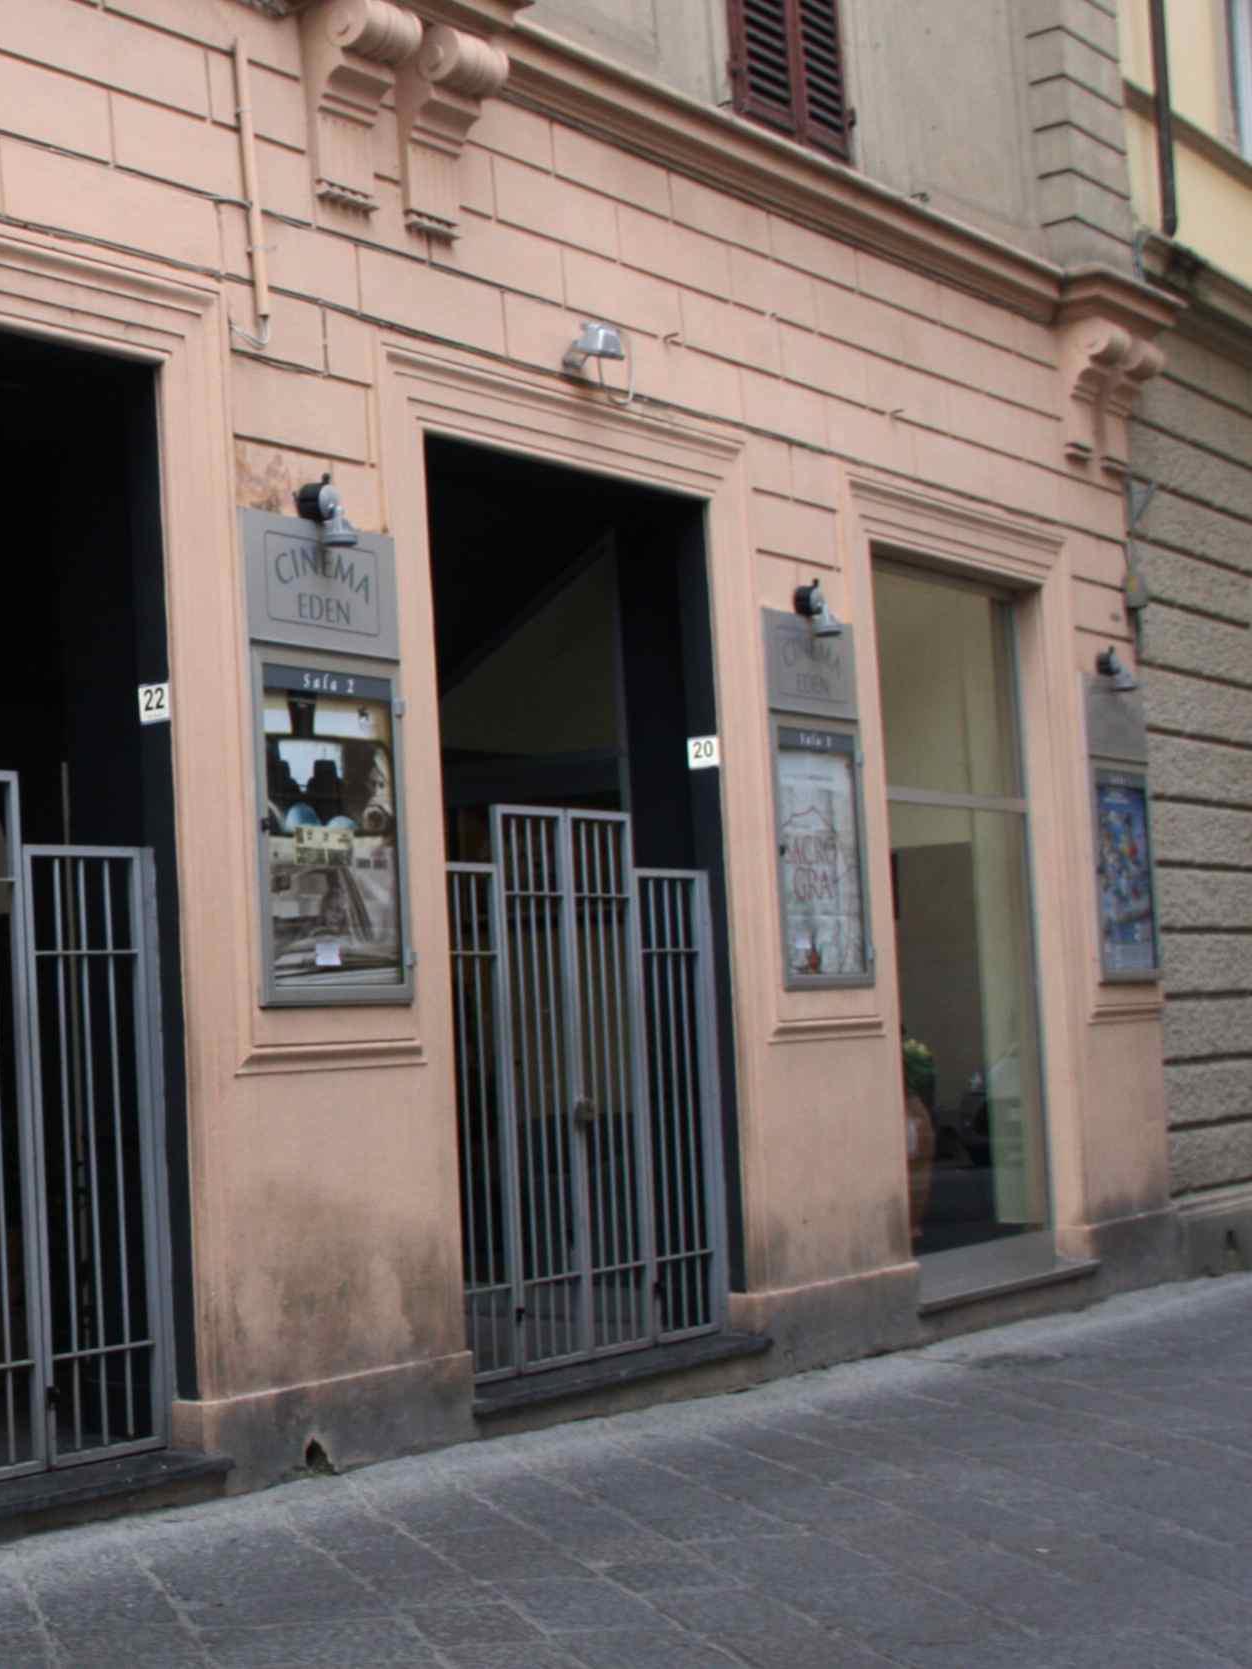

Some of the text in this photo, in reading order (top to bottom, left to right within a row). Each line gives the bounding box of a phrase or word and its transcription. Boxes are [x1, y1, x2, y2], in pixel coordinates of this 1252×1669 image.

[275, 545, 370, 606] CINEMA
[297, 591, 351, 625] EDEN
[303, 673, 337, 692] Sala
[143, 687, 165, 712] 22
[692, 740, 715, 760] 20
